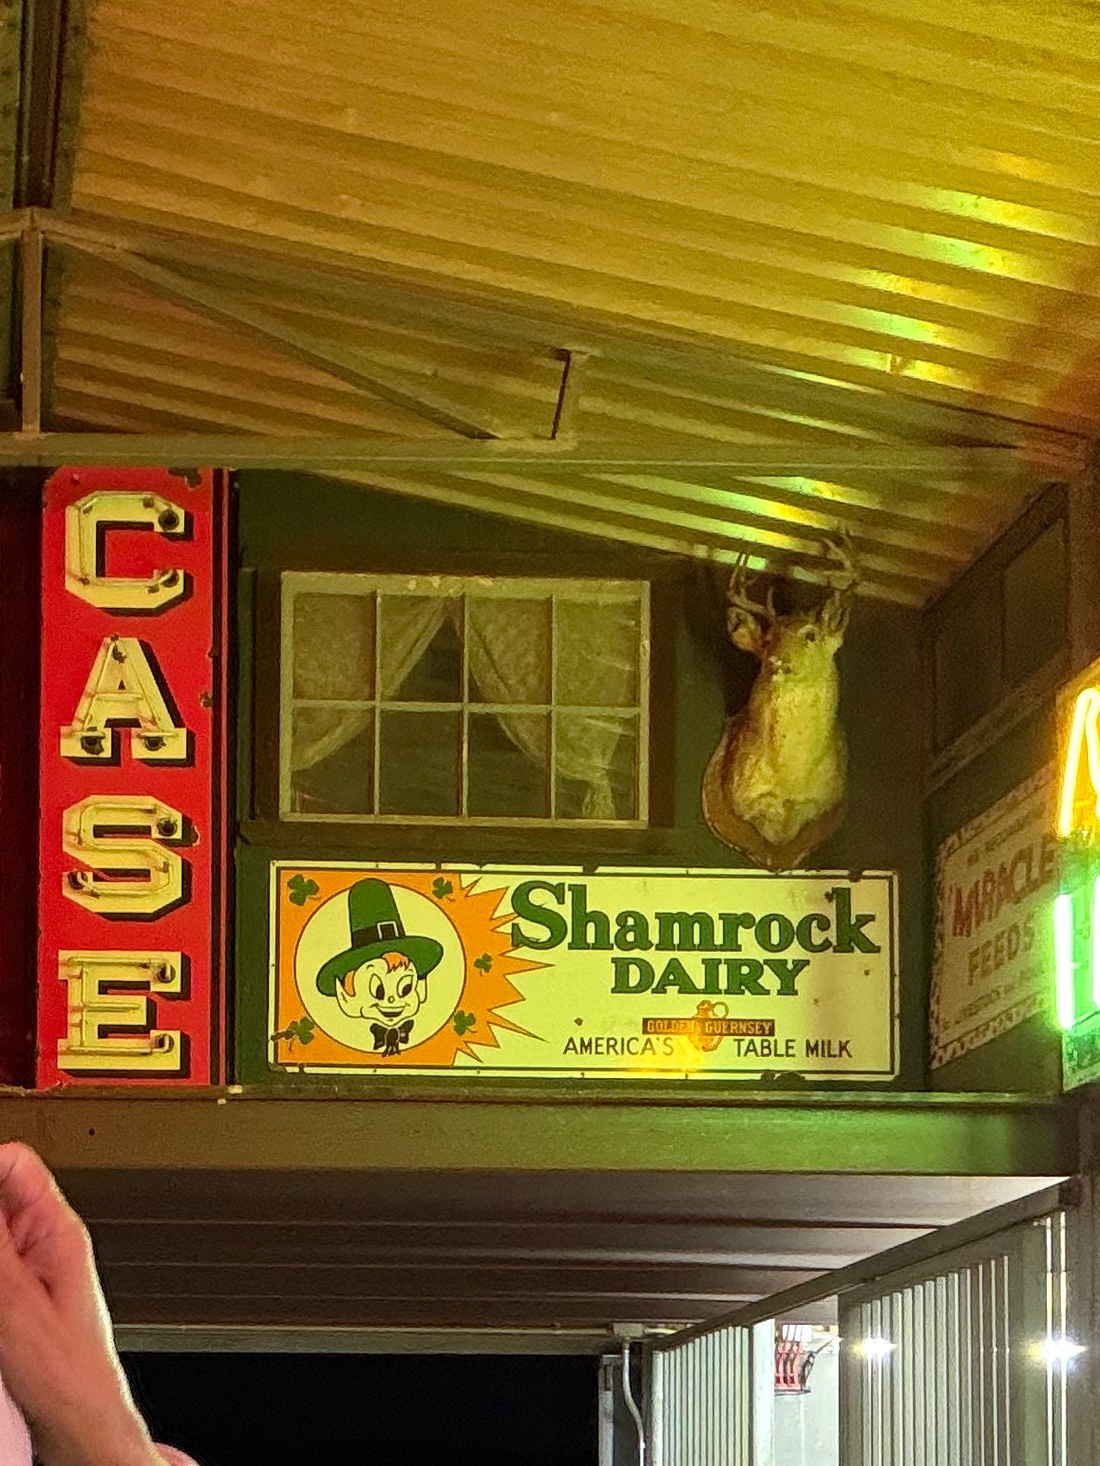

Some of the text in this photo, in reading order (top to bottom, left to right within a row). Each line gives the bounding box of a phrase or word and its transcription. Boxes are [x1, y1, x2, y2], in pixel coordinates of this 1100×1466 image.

[58, 491, 192, 1074] CASE
[511, 880, 881, 953] Shamrock
[611, 957, 810, 996] DAIRY
[967, 911, 1036, 987] FEEDS
[562, 1036, 853, 1058] AMERICA'S TABLE MILK
[704, 1019, 772, 1036] GUERNSEY
